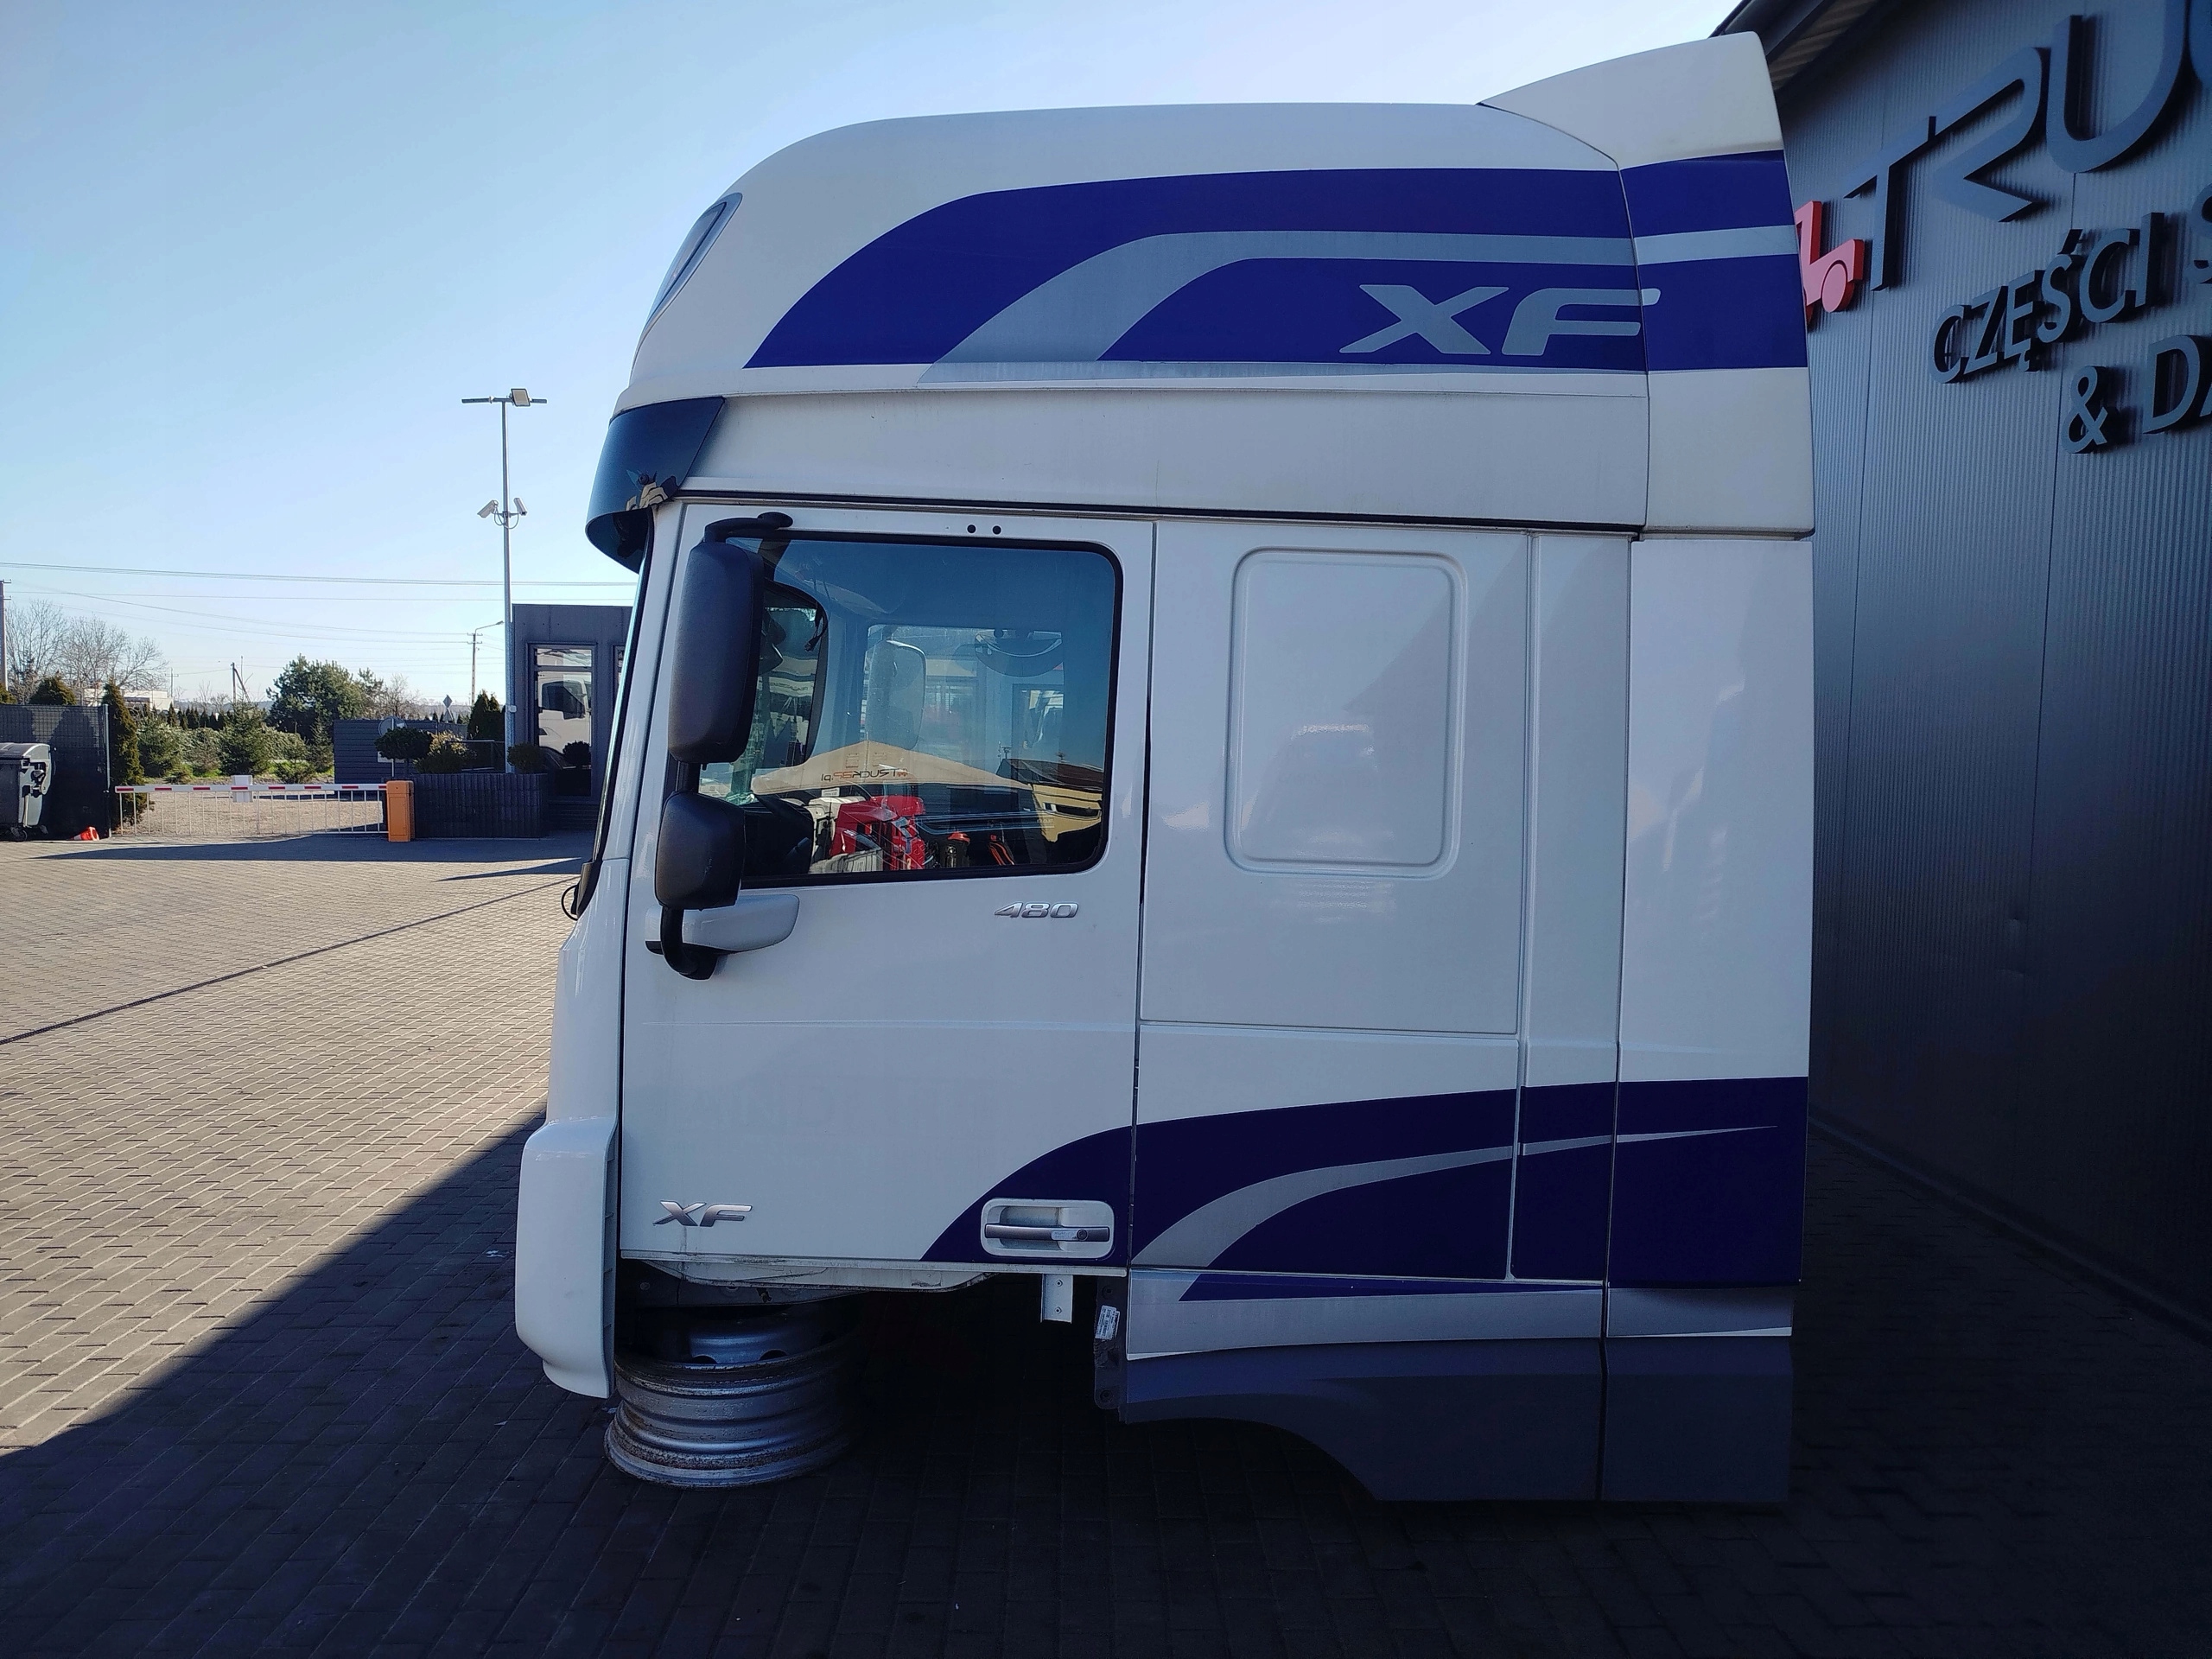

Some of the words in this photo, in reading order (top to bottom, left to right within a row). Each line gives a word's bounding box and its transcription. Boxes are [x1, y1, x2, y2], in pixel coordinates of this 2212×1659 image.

[1339, 284, 1661, 356] XF
[1928, 213, 2159, 384] CZĘŚCI
[2061, 366, 2108, 454] &
[2142, 334, 2212, 435] D
[995, 902, 1079, 918] 480
[652, 1200, 753, 1227] XF
